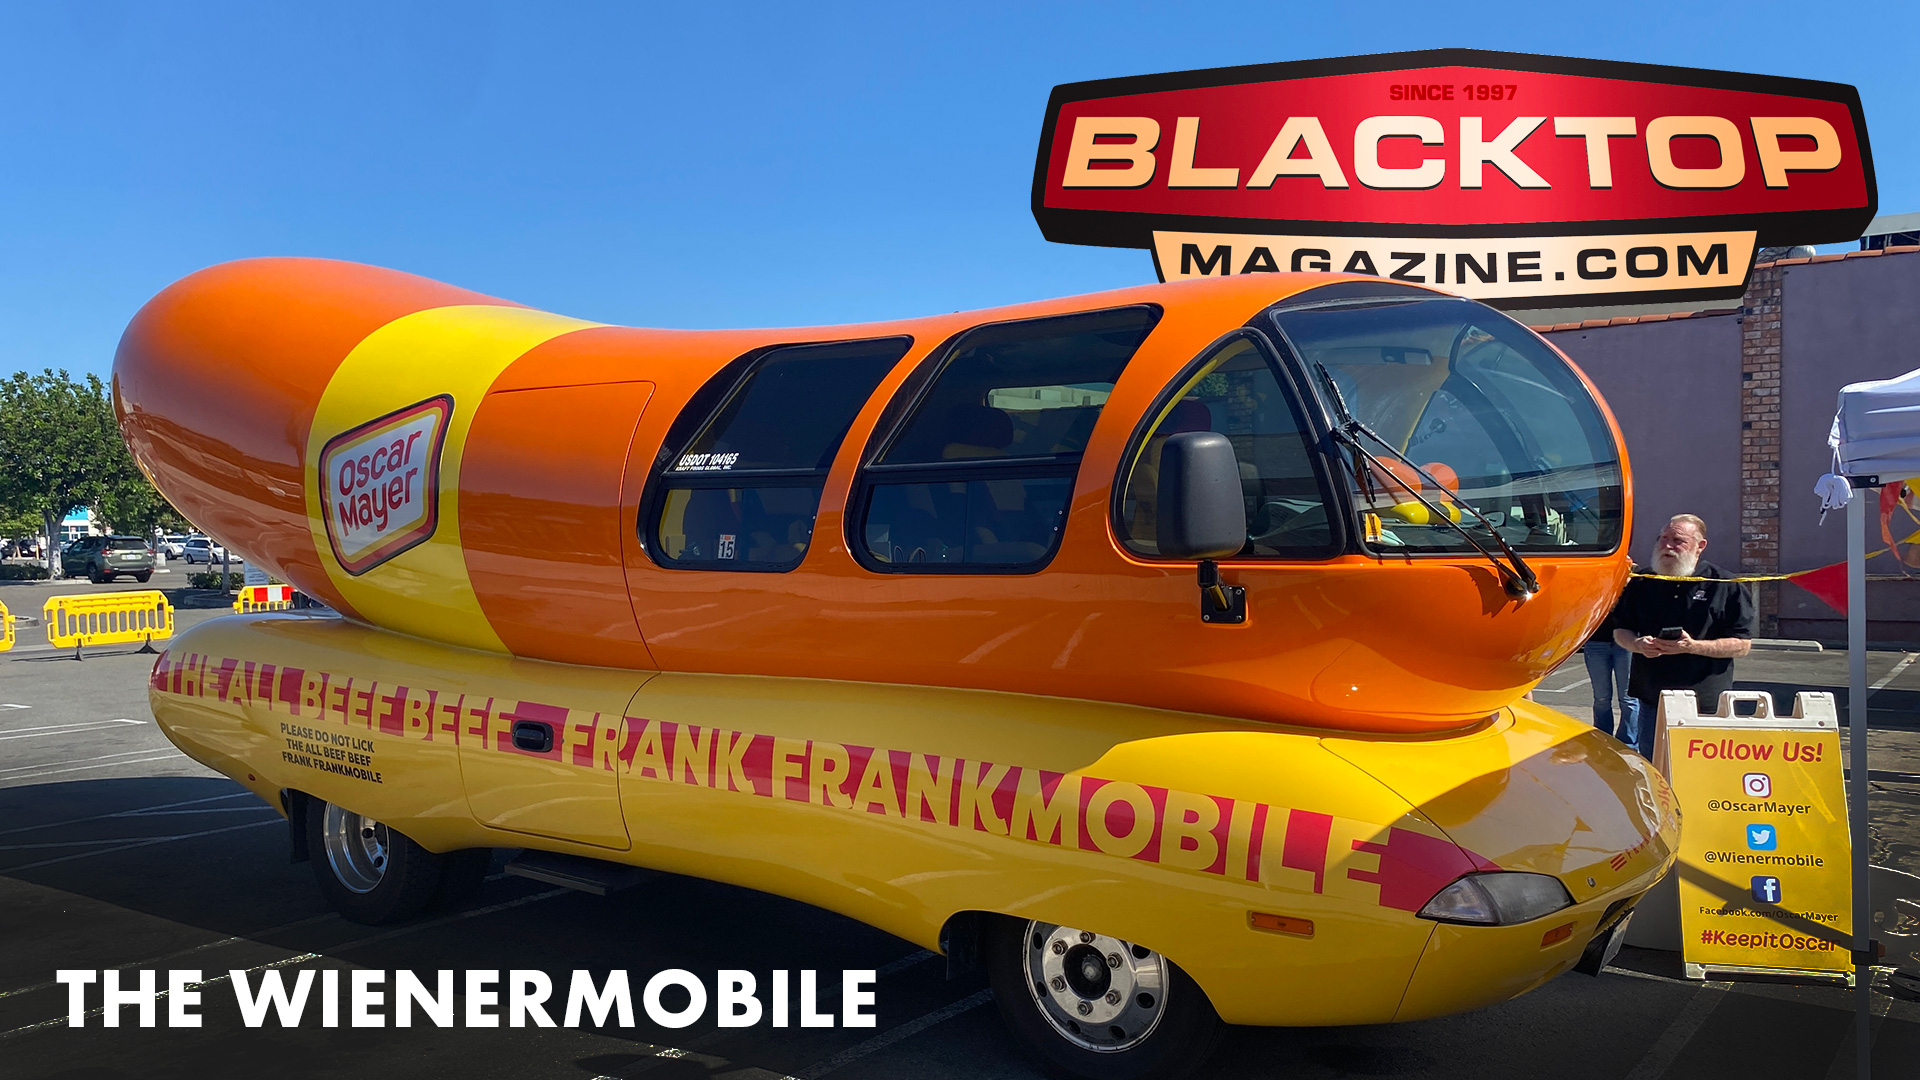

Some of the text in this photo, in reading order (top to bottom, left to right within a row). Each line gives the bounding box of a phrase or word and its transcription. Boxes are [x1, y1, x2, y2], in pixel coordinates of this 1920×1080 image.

[339, 430, 423, 496] Oscar
[679, 452, 740, 467] USDOT 104165
[338, 467, 419, 537] Mayer
[720, 541, 734, 558] 15
[280, 722, 375, 753] PLEASE DO NOT LICK
[286, 738, 371, 767] THE ALL BEEF BEEF
[1687, 738, 1823, 762] Follow Us!
[166, 652, 1392, 906] THE ALL BEEF BEEF FRANK FRANKMOBILE
[282, 751, 383, 784] FRANK FRANKMOBILE
[1707, 799, 1811, 816] @OscarMayer
[1704, 850, 1824, 868] @Wienermobile
[1699, 906, 1839, 923] Facebook.com/OscarMayer
[1701, 929, 1842, 952] #KeepitOscar
